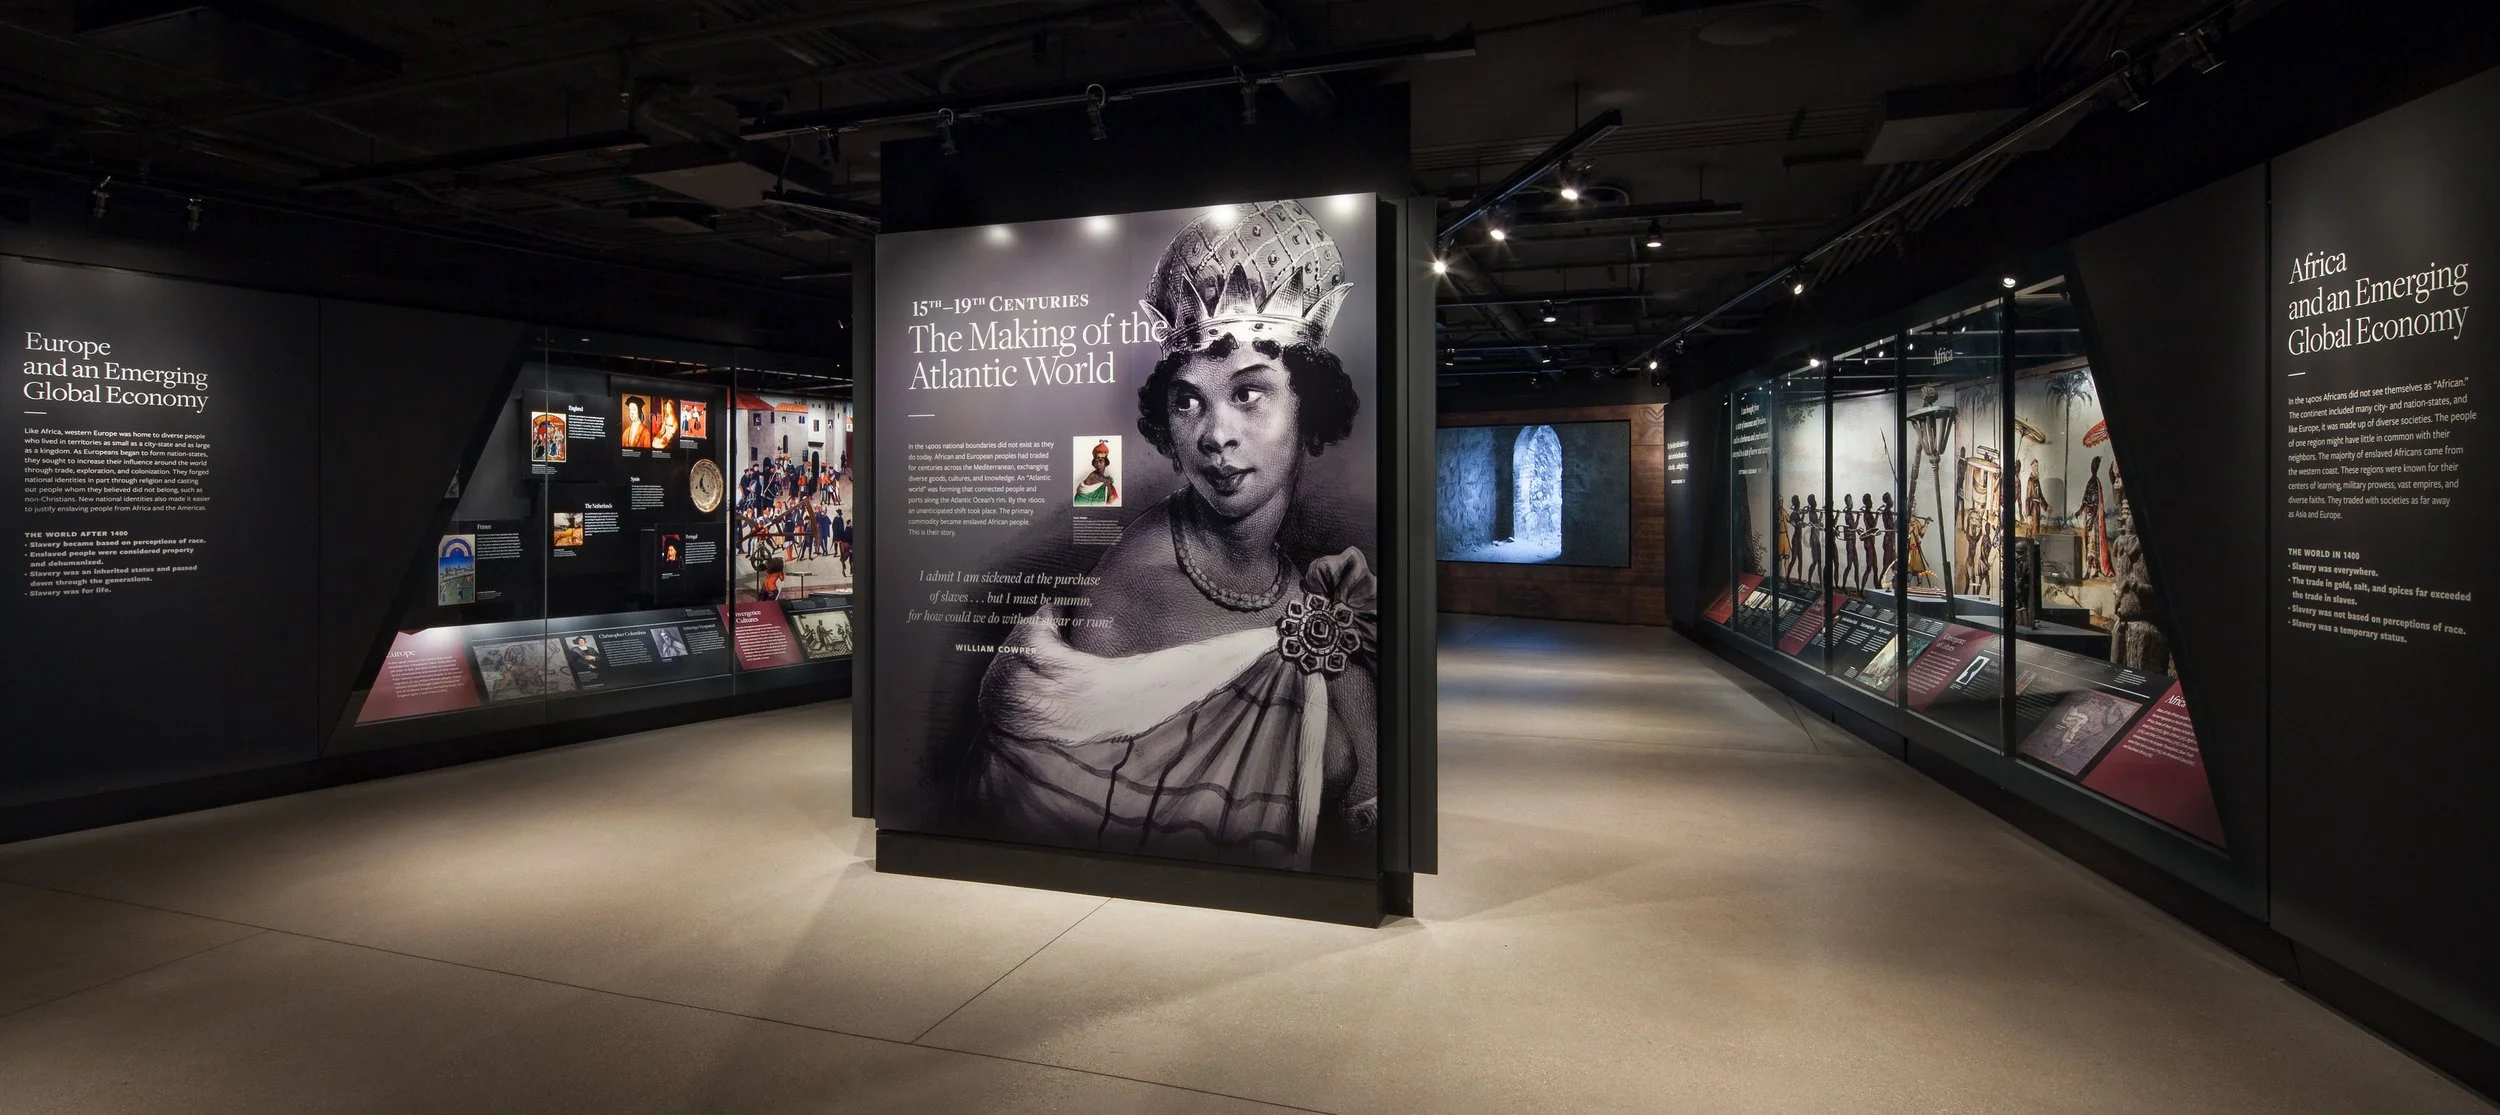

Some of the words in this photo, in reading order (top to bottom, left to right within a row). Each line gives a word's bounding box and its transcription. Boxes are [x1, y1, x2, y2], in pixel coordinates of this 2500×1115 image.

[2289, 251, 2347, 285] Africa
[2289, 287, 2324, 320] and
[2327, 290, 2351, 313] an
[2355, 262, 2469, 307] Emerging
[908, 322, 963, 354] The
[968, 318, 1076, 358] Making
[1082, 313, 1115, 346] of
[1120, 311, 1168, 344] the
[2288, 319, 2352, 356] Global
[2356, 305, 2469, 345] Economy
[25, 331, 111, 360] Europe
[1933, 347, 1953, 365] Africa
[24, 358, 67, 376] and
[72, 364, 99, 379] an
[104, 362, 209, 390] Emerging
[908, 358, 1017, 390] Atlantic
[1022, 351, 1116, 386] World
[24, 381, 101, 403] Global
[106, 386, 209, 414] Economy
[2305, 394, 2322, 405] 1400s
[2323, 391, 2347, 402] Africans
[2384, 383, 2422, 395] themselves
[94, 430, 117, 438] Europe
[925, 443, 941, 451] 1400s
[965, 441, 997, 449] boundaries
[1041, 441, 1054, 449] they
[133, 538, 176, 546] perceptions
[2288, 548, 2302, 556] THE
[2304, 549, 2330, 558] WORLD
[2343, 551, 2360, 560] 1400
[2292, 563, 2317, 573] Slavery
[2318, 565, 2332, 573] was
[2333, 566, 2378, 577] everywhere.
[55, 578, 88, 586] through
[105, 576, 153, 584] generations.
[926, 571, 955, 582] admit
[963, 574, 979, 582] am
[981, 571, 1021, 584] sickened
[1023, 575, 1034, 584] at
[1036, 571, 1052, 584] the
[1053, 573, 1101, 588] purchase
[2292, 577, 2304, 585] The
[2306, 578, 2324, 586] trade
[2334, 580, 2352, 590] gold,
[2354, 582, 2370, 592] salt,
[2372, 584, 2386, 593] and
[2388, 585, 2413, 596] spices
[2415, 587, 2428, 597] far
[2430, 590, 2471, 601] exceeded
[929, 590, 940, 604] of
[941, 591, 968, 603] slaves
[987, 592, 1003, 603] but
[1013, 595, 1037, 605] must
[1040, 593, 1052, 605] be
[1053, 596, 1093, 607] mumm,
[2305, 592, 2323, 601] trade
[2333, 595, 2358, 605] slaves.
[906, 610, 921, 623] for
[924, 610, 943, 622] how
[945, 611, 971, 623] could
[973, 614, 986, 623] we
[987, 612, 1000, 623] do
[1002, 612, 1040, 625] without
[1042, 617, 1068, 628] sugar
[1072, 618, 1084, 627] or
[1086, 617, 1114, 628] rum?
[2292, 605, 2317, 617] Slavery
[2318, 609, 2332, 617] was
[2333, 610, 2346, 619] not
[2347, 611, 2369, 622] based
[2383, 616, 2430, 631] perceptions
[2444, 624, 2466, 635] race.
[2292, 619, 2317, 631] Slavery
[2318, 624, 2332, 632] was
[2340, 626, 2378, 640] temporary
[2380, 632, 2407, 643] status.
[955, 643, 994, 653] WILLIAM
[998, 645, 1036, 655] COWPER
[2165, 695, 2187, 708] Africa
